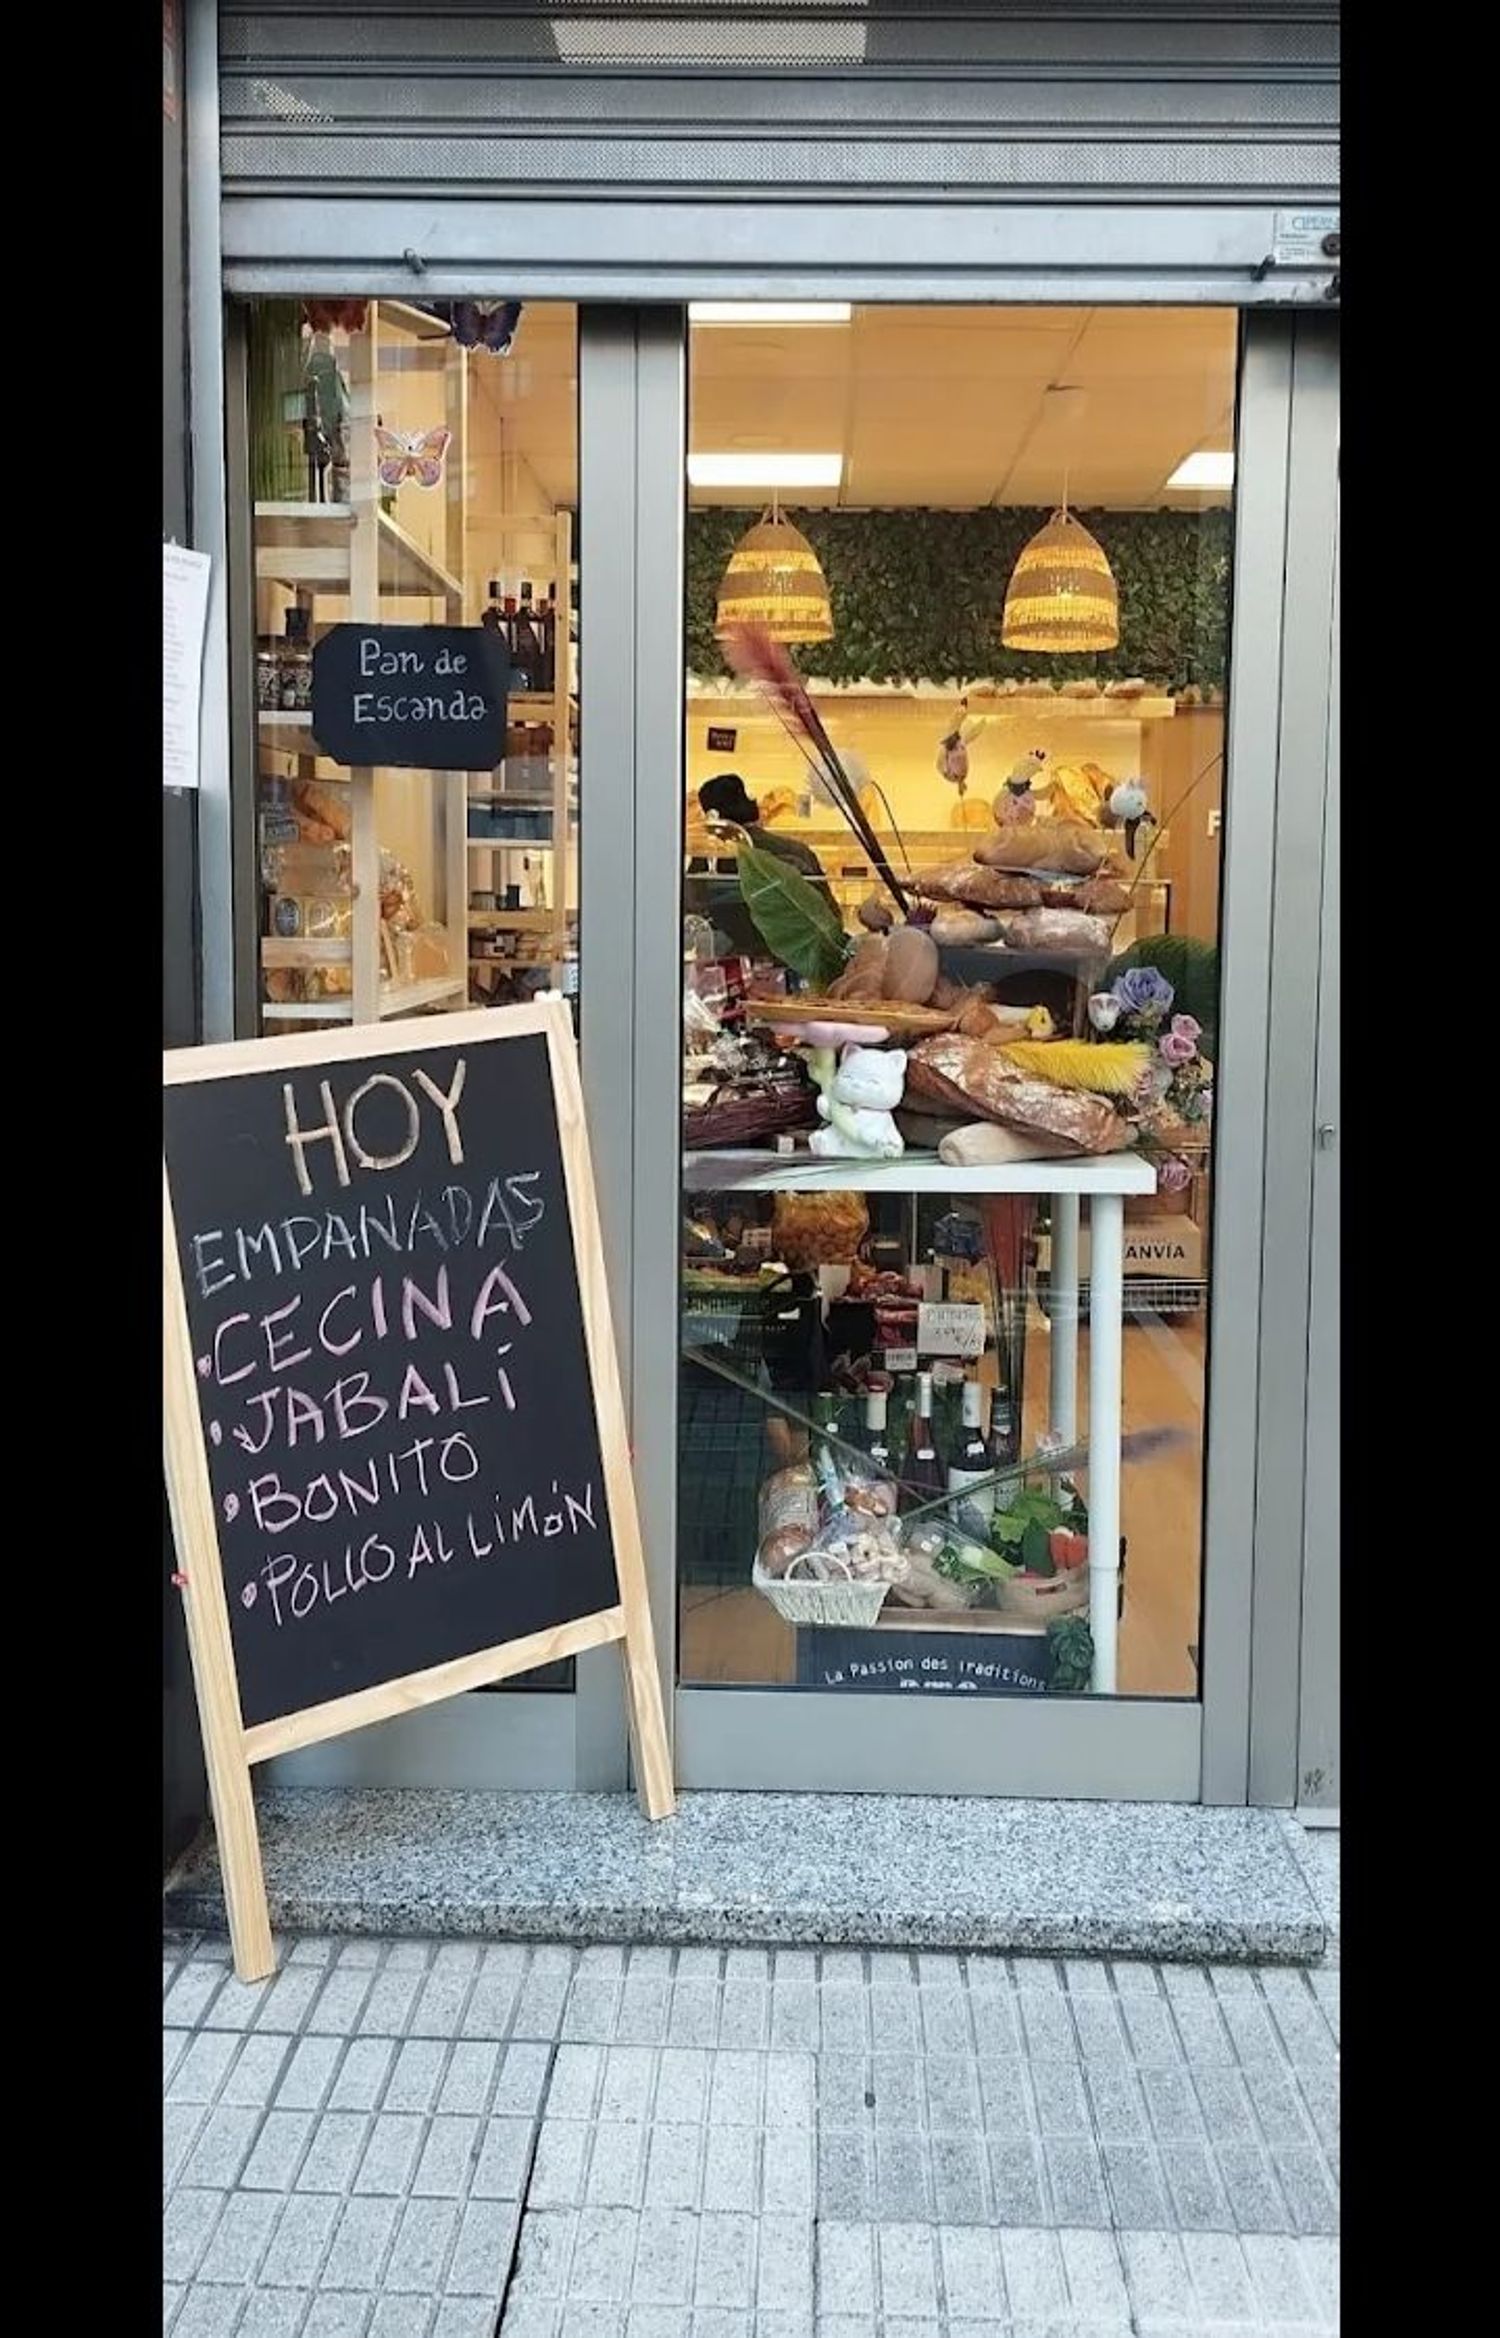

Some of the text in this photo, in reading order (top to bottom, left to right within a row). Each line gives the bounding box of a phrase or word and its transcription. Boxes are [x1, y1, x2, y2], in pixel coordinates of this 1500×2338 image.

[353, 690, 488, 723] Escanda
[360, 638, 468, 676] Pan de
[283, 1059, 465, 1195] HOY
[191, 1171, 546, 1298] EMPANADAS
[1124, 1242, 1185, 1259] ANVÍA
[214, 1259, 533, 1385] CECINA
[249, 1431, 479, 1533] BONITO
[262, 1533, 395, 1625] POLLO
[408, 1522, 454, 1579] AL
[825, 1671, 844, 1685] La
[850, 1657, 914, 1678] Passion
[921, 1656, 948, 1671] des
